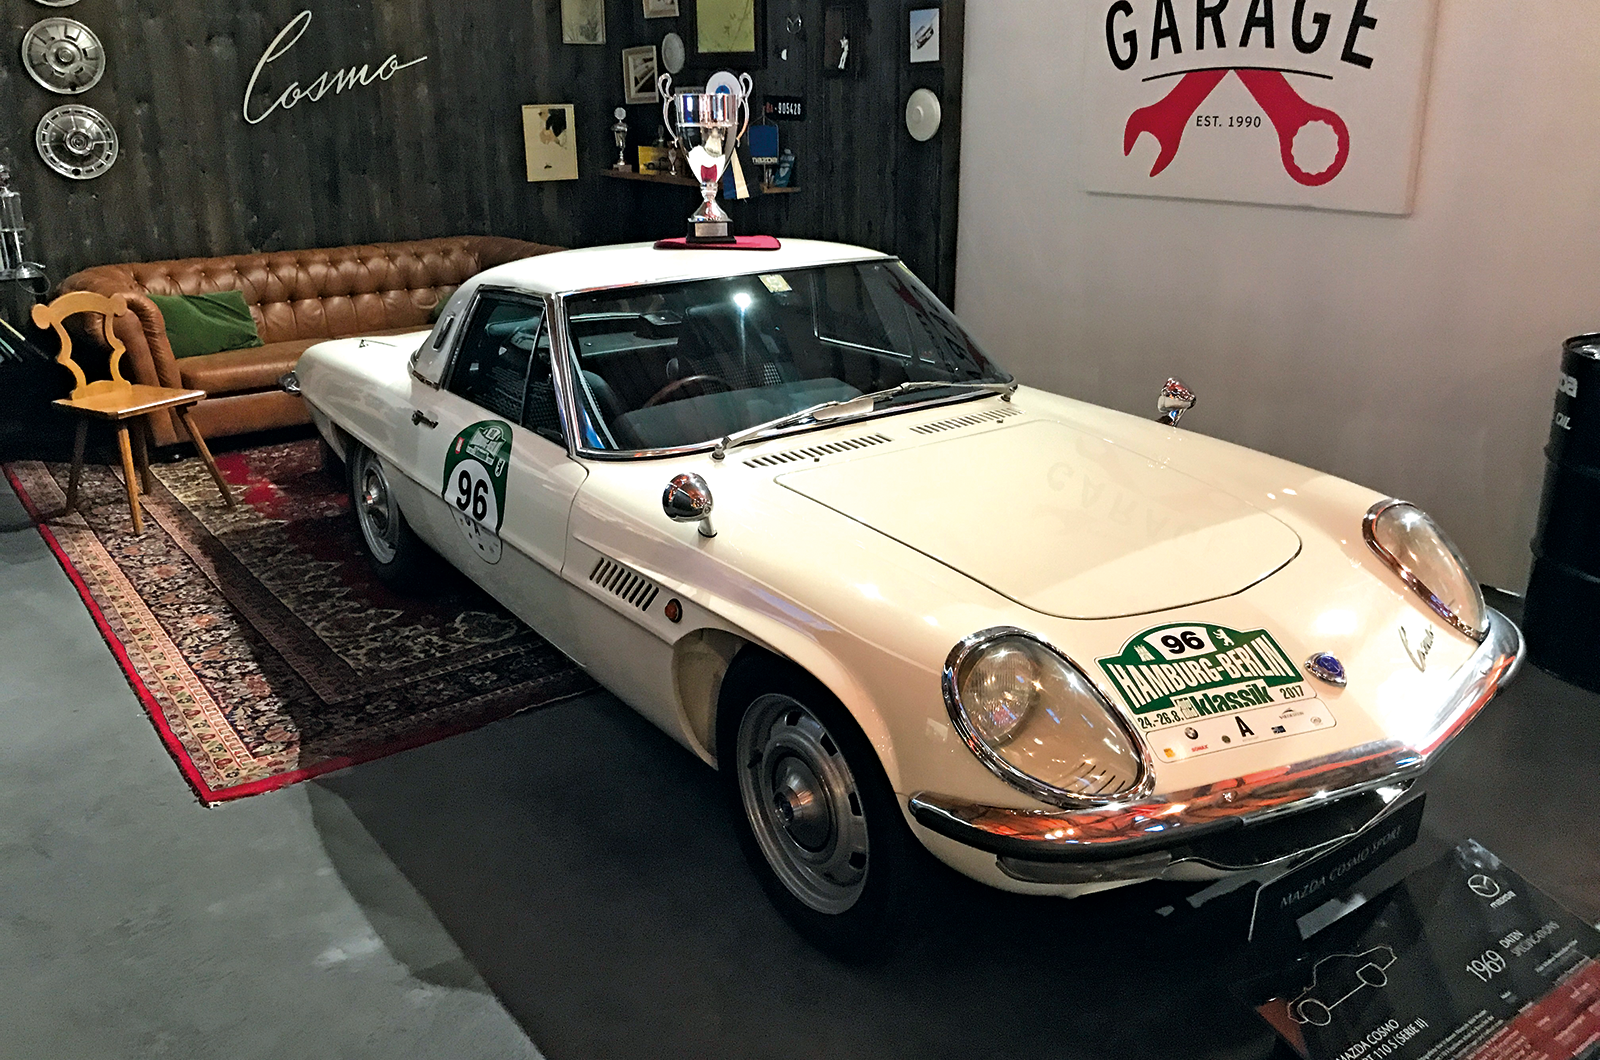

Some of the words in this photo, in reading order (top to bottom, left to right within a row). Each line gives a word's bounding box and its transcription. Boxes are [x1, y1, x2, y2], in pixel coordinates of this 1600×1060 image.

[1105, 0, 1378, 71] GARAGE
[243, 10, 428, 124] Cosmo
[1196, 115, 1223, 127] EST.
[1228, 115, 1262, 128] 1990
[456, 469, 489, 521] 96
[1160, 631, 1205, 654] 96
[1106, 634, 1296, 709] HAMBURG-BERLIN
[1190, 683, 1275, 716] klassik
[1279, 685, 1305, 699] 2017
[1234, 715, 1255, 737] A
[1280, 876, 1326, 909] MAZDA
[1329, 847, 1370, 882] COSMO
[1499, 929, 1524, 949] DATEN
[1466, 949, 1506, 982] 1969
[1366, 1019, 1400, 1045] COSMO
[1373, 1043, 1392, 1059] 110
[1387, 1039, 1398, 1049] S
[1393, 1023, 1420, 1046] (SERIE
